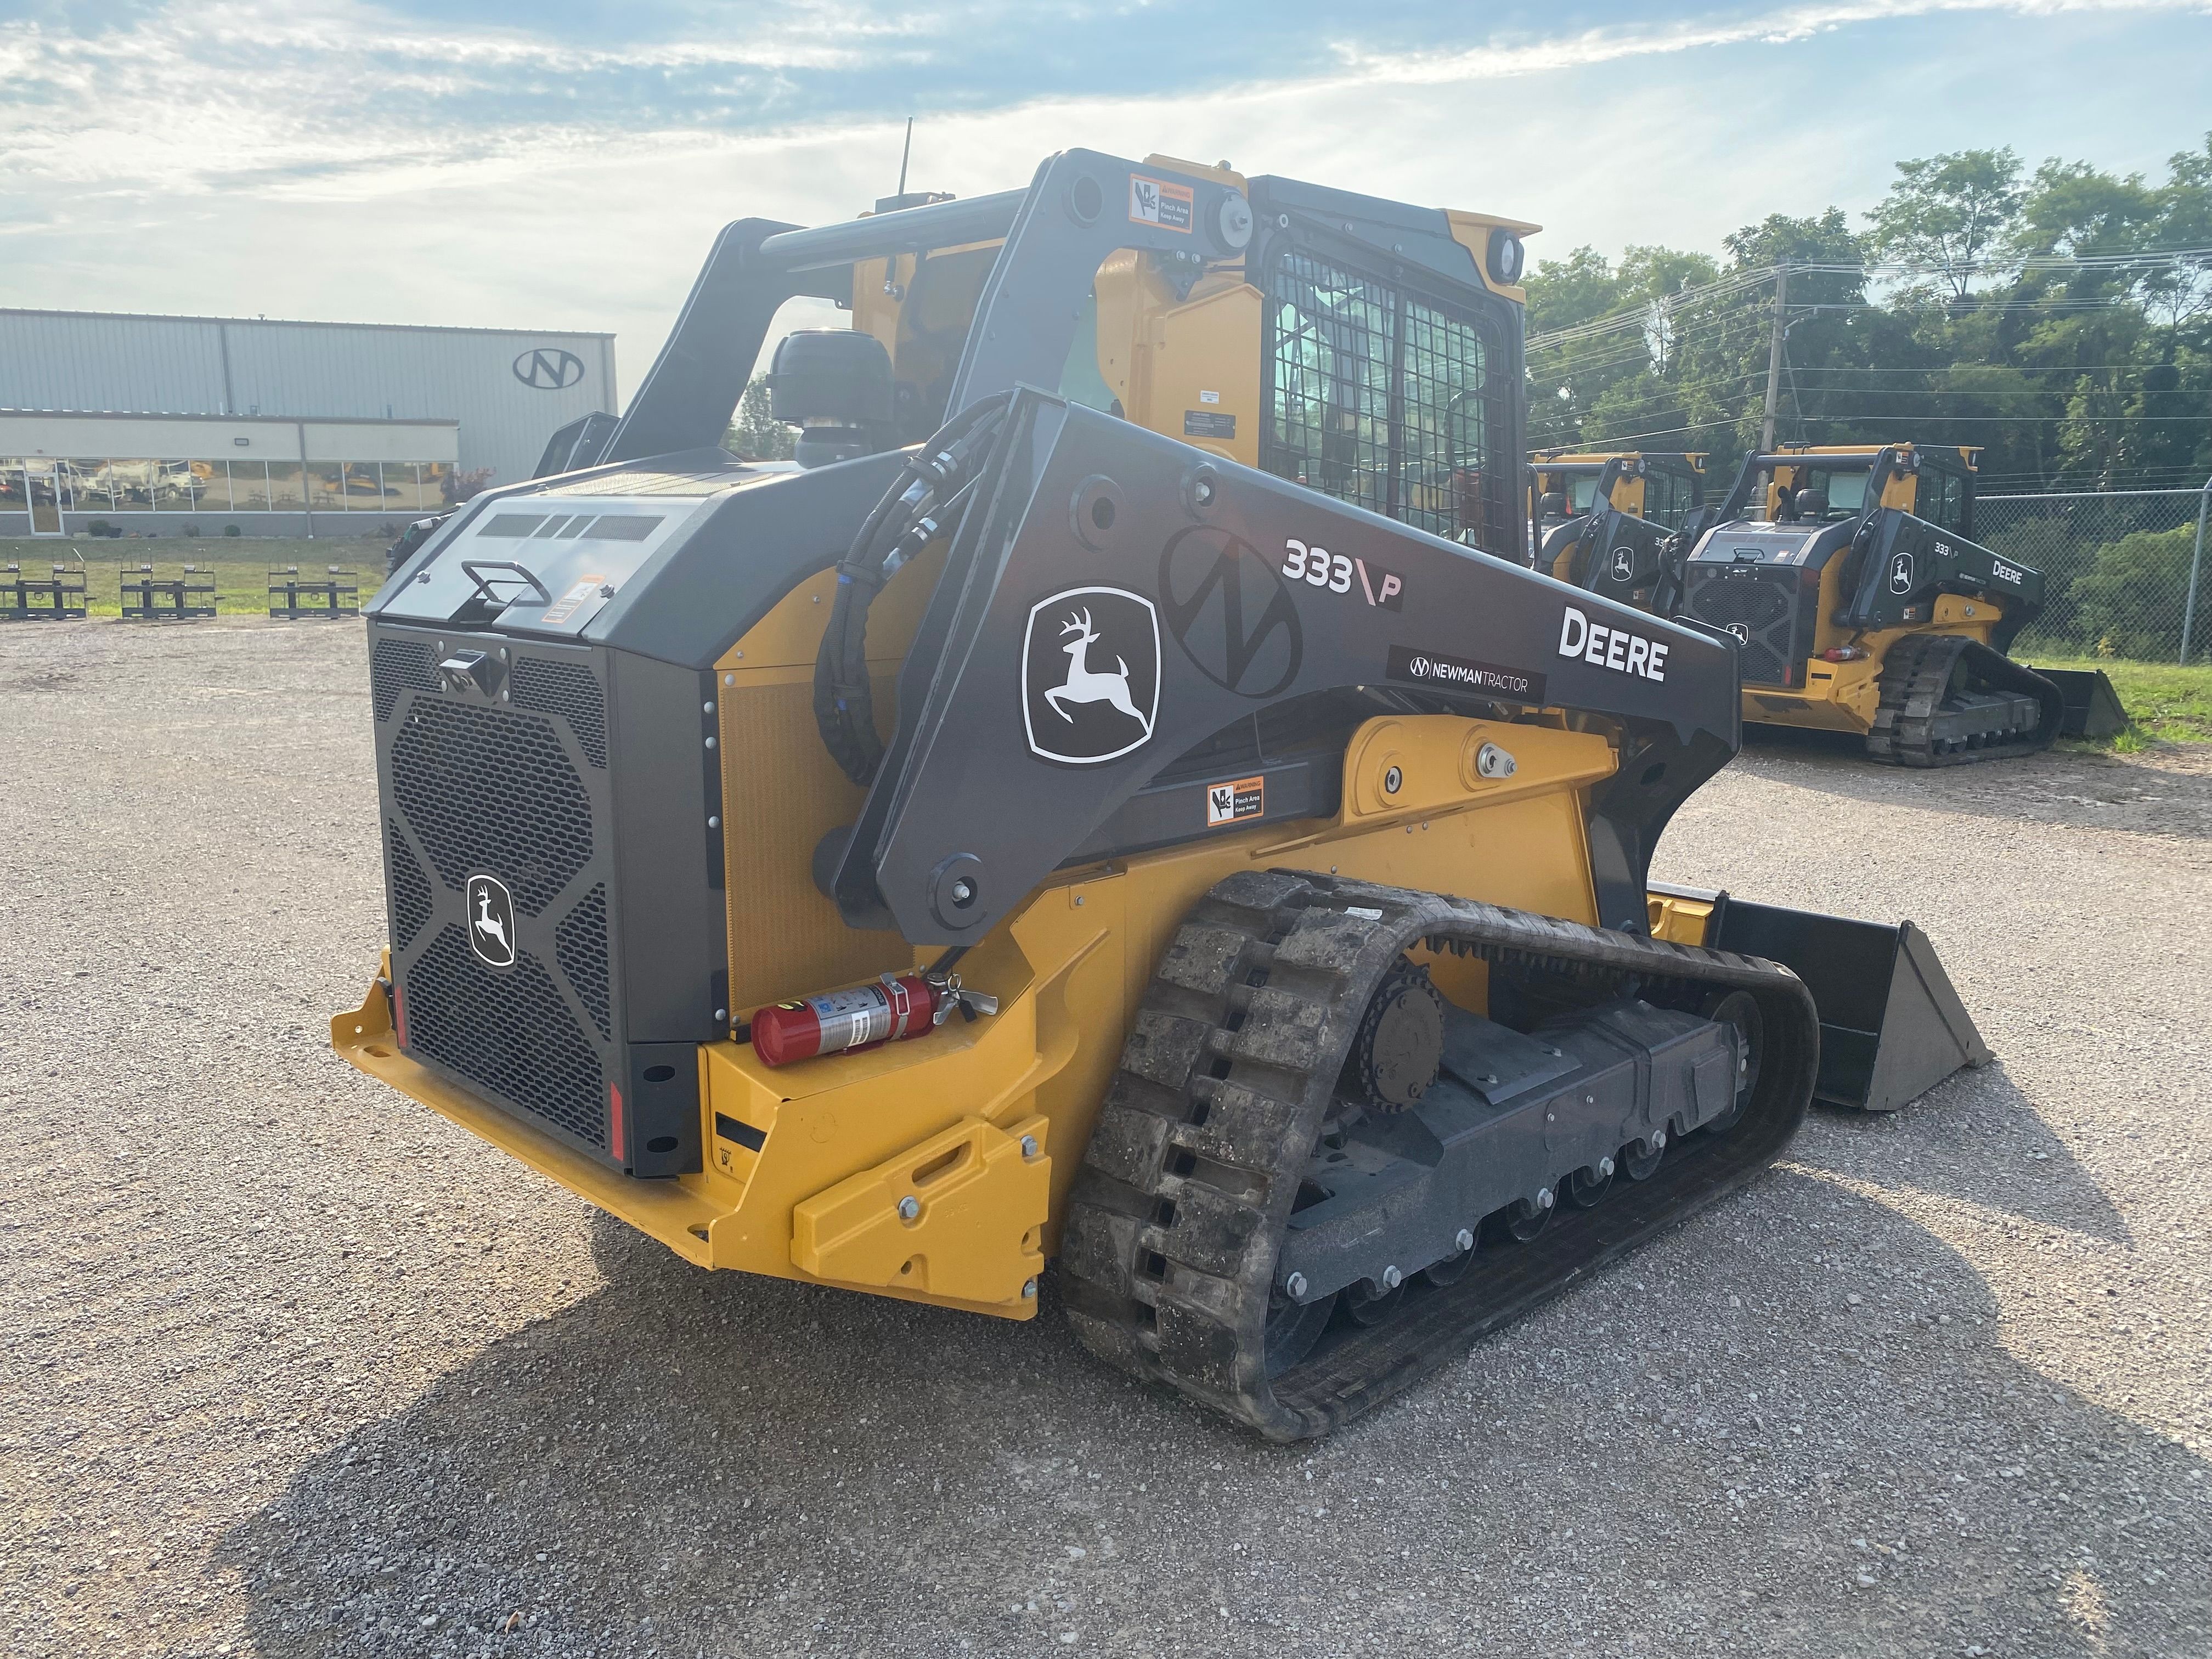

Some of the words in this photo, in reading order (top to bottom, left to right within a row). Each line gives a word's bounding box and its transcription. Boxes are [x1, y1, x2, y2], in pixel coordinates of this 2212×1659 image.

[1161, 202, 1176, 211] Pinch
[1176, 206, 1189, 215] Area
[1160, 212, 1172, 221] Keep
[1172, 215, 1184, 224] Away
[1993, 560, 2023, 585] DEERE
[1558, 606, 1669, 682] DEERE
[1240, 780, 1261, 789] WARNING
[1235, 797, 1249, 805] Pinch
